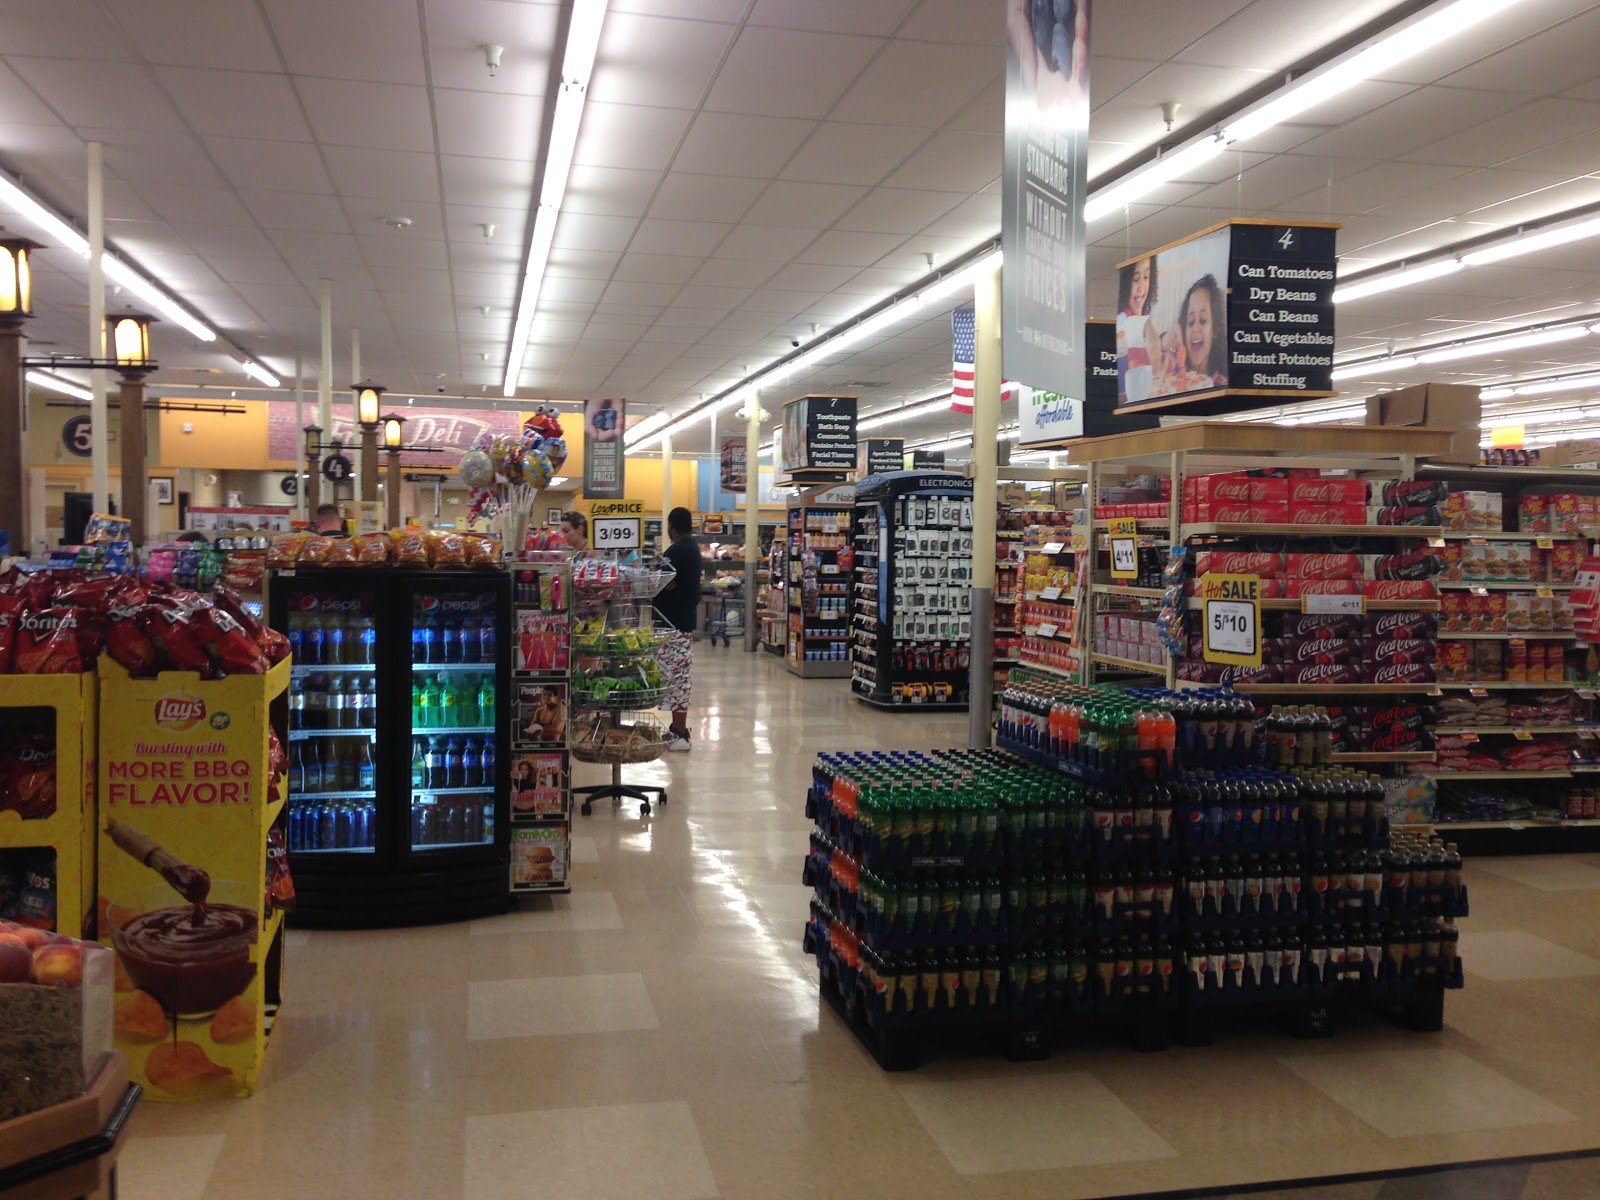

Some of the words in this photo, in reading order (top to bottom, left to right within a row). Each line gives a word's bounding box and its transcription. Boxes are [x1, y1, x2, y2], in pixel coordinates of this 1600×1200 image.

[1278, 228, 1294, 249] 4
[1238, 265, 1265, 278] Can
[1267, 266, 1334, 280] Tomatoes
[1250, 287, 1274, 303] Dry
[1276, 289, 1317, 301] Beans
[1249, 310, 1276, 322] Can
[1278, 311, 1319, 323] Beans
[1233, 331, 1261, 343] Can
[1263, 332, 1334, 347] Vegetables
[1100, 352, 1117, 363] Dry
[1232, 352, 1277, 364] Instant
[1278, 353, 1331, 366] Potatoes
[1093, 367, 1118, 376] Pasta
[1252, 373, 1306, 389] Stuffing
[831, 398, 838, 407] 7
[74, 423, 92, 450] 5
[404, 417, 463, 447] Deli
[328, 459, 344, 478] 4
[286, 480, 297, 493] 2
[919, 479, 973, 488] ELECTRONICS
[1117, 521, 1134, 534] SALE
[1223, 580, 1257, 600] SALE
[322, 599, 361, 613] pepsi
[442, 599, 480, 613] pepsi
[1214, 614, 1247, 633] 5/$10
[135, 741, 193, 758] Bursting
[194, 742, 226, 756] with
[108, 761, 184, 778] MORE
[193, 760, 250, 778] BBQ
[108, 782, 252, 806] FLAVOR!
